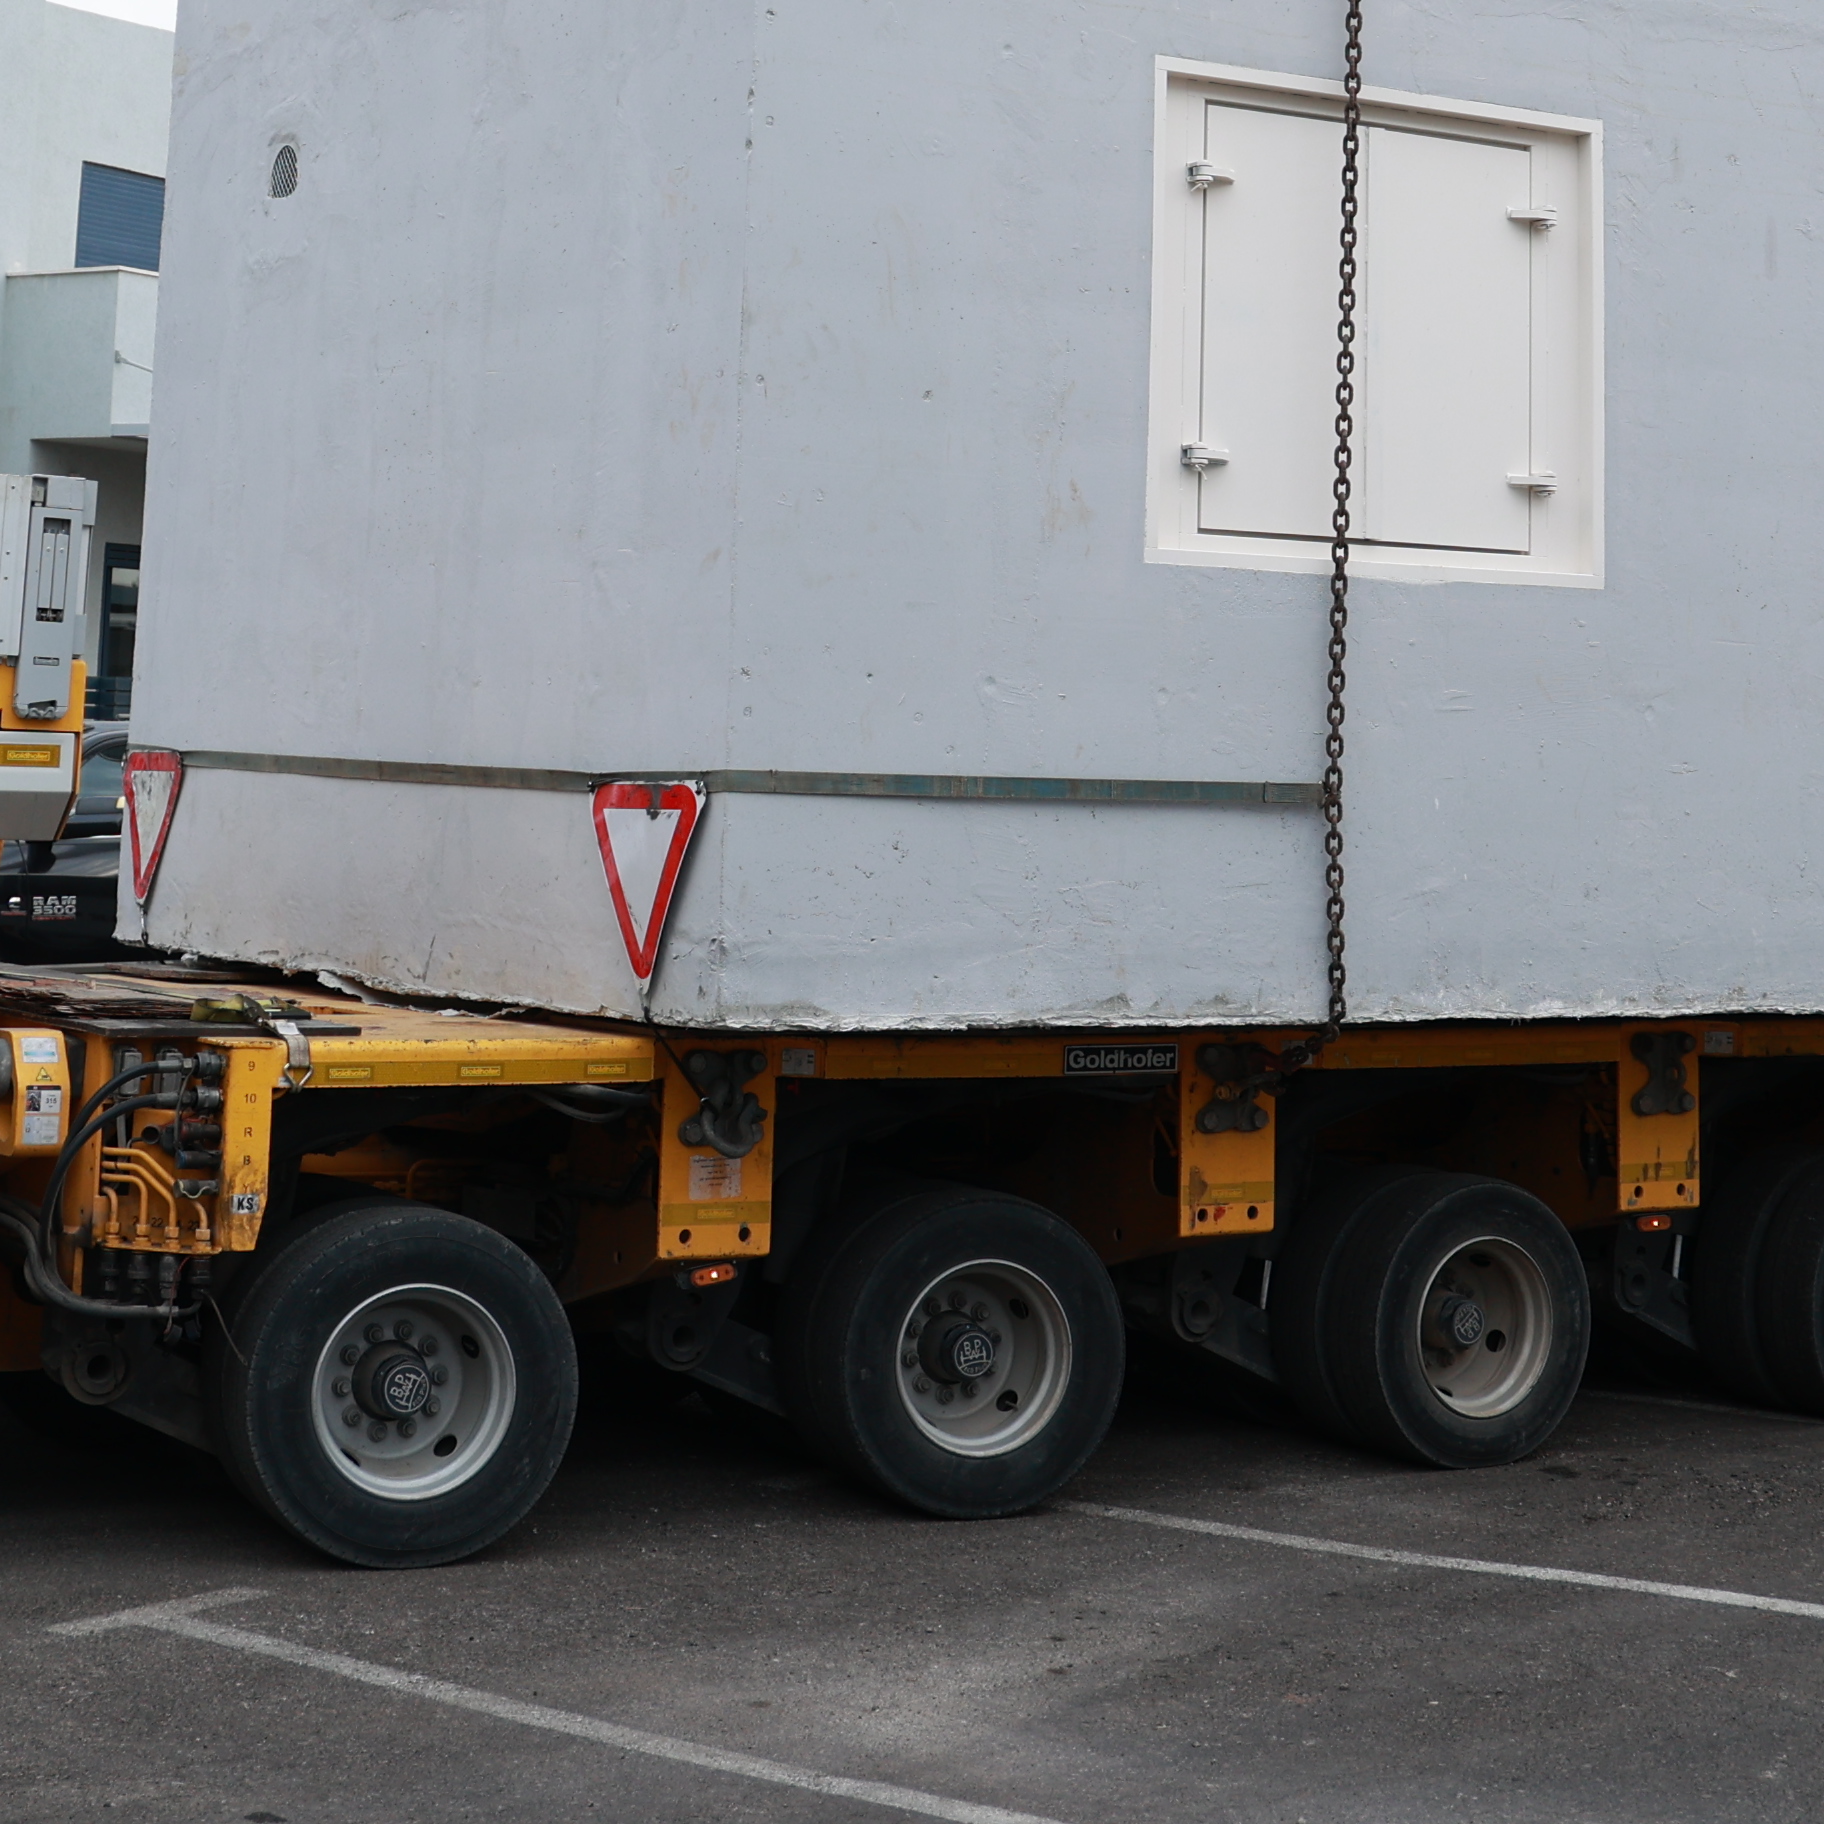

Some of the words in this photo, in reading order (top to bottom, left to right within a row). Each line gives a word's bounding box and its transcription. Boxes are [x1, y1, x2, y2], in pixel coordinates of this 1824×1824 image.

[33, 895, 76, 906] RAM
[33, 905, 77, 915] 3500
[1068, 1047, 1175, 1071] Goldhofer
[247, 1060, 256, 1072] 9
[243, 1093, 257, 1104] 10
[243, 1127, 253, 1138] R
[243, 1156, 252, 1166] B
[237, 1196, 254, 1210] KS
